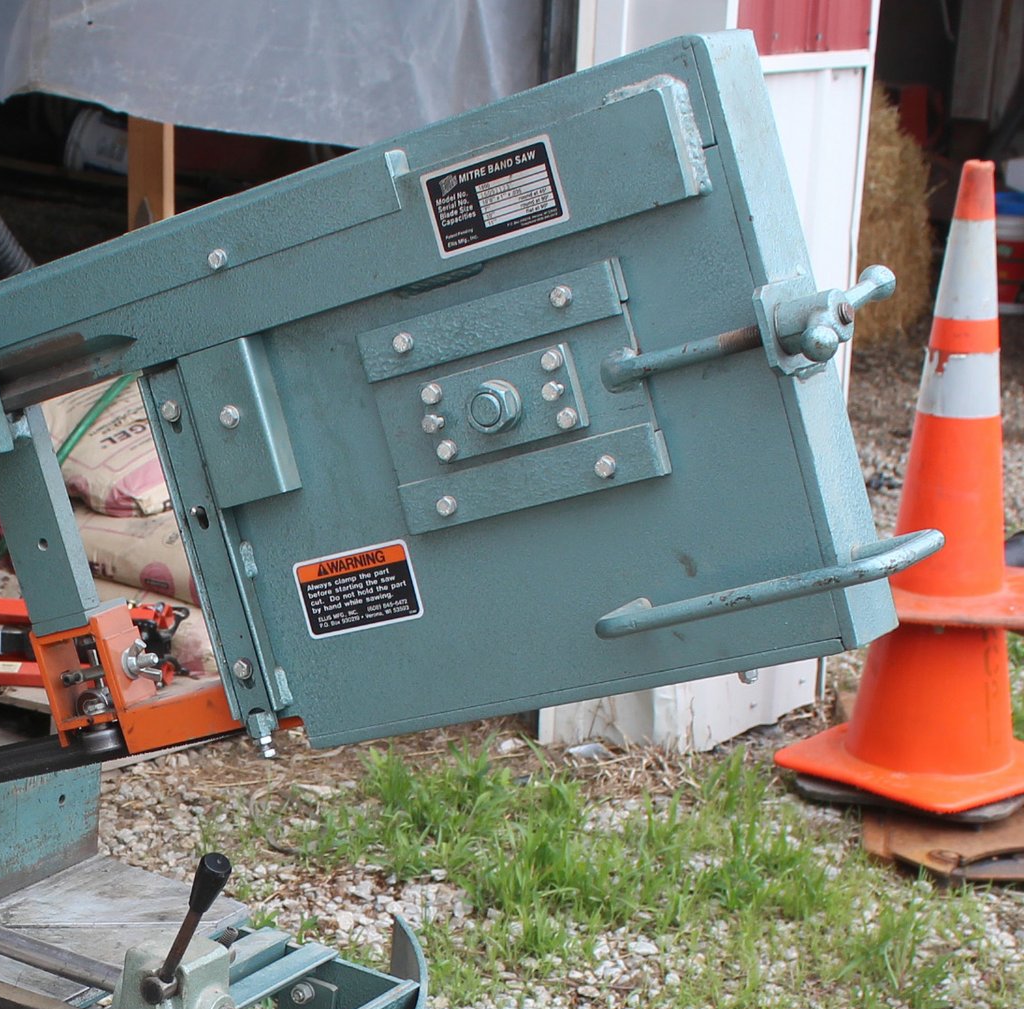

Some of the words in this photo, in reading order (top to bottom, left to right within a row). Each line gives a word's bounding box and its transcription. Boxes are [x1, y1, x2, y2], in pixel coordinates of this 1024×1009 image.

[458, 166, 487, 184] MITRE
[487, 158, 513, 174] BAND
[514, 150, 536, 165] SAW
[436, 194, 456, 206] Model
[457, 191, 468, 200] No.
[437, 201, 457, 213] Serial
[458, 198, 469, 207] No.
[439, 209, 458, 220] Blade
[459, 204, 473, 214] Size
[441, 212, 476, 227] Capacities
[327, 550, 386, 574] WARNING
[307, 581, 332, 592] Always
[334, 575, 357, 586] clamp
[374, 568, 390, 578] part
[308, 590, 333, 599] before
[335, 582, 364, 593] starting
[366, 579, 378, 587] the
[380, 575, 395, 583] saw
[310, 599, 325, 607] cut.
[343, 591, 355, 600] not
[357, 587, 373, 597] hold
[391, 580, 406, 590] part
[312, 607, 321, 615] by
[323, 603, 342, 612] hand
[344, 599, 363, 607] while
[366, 592, 394, 602] sawing.
[318, 615, 332, 623] ELLIS
